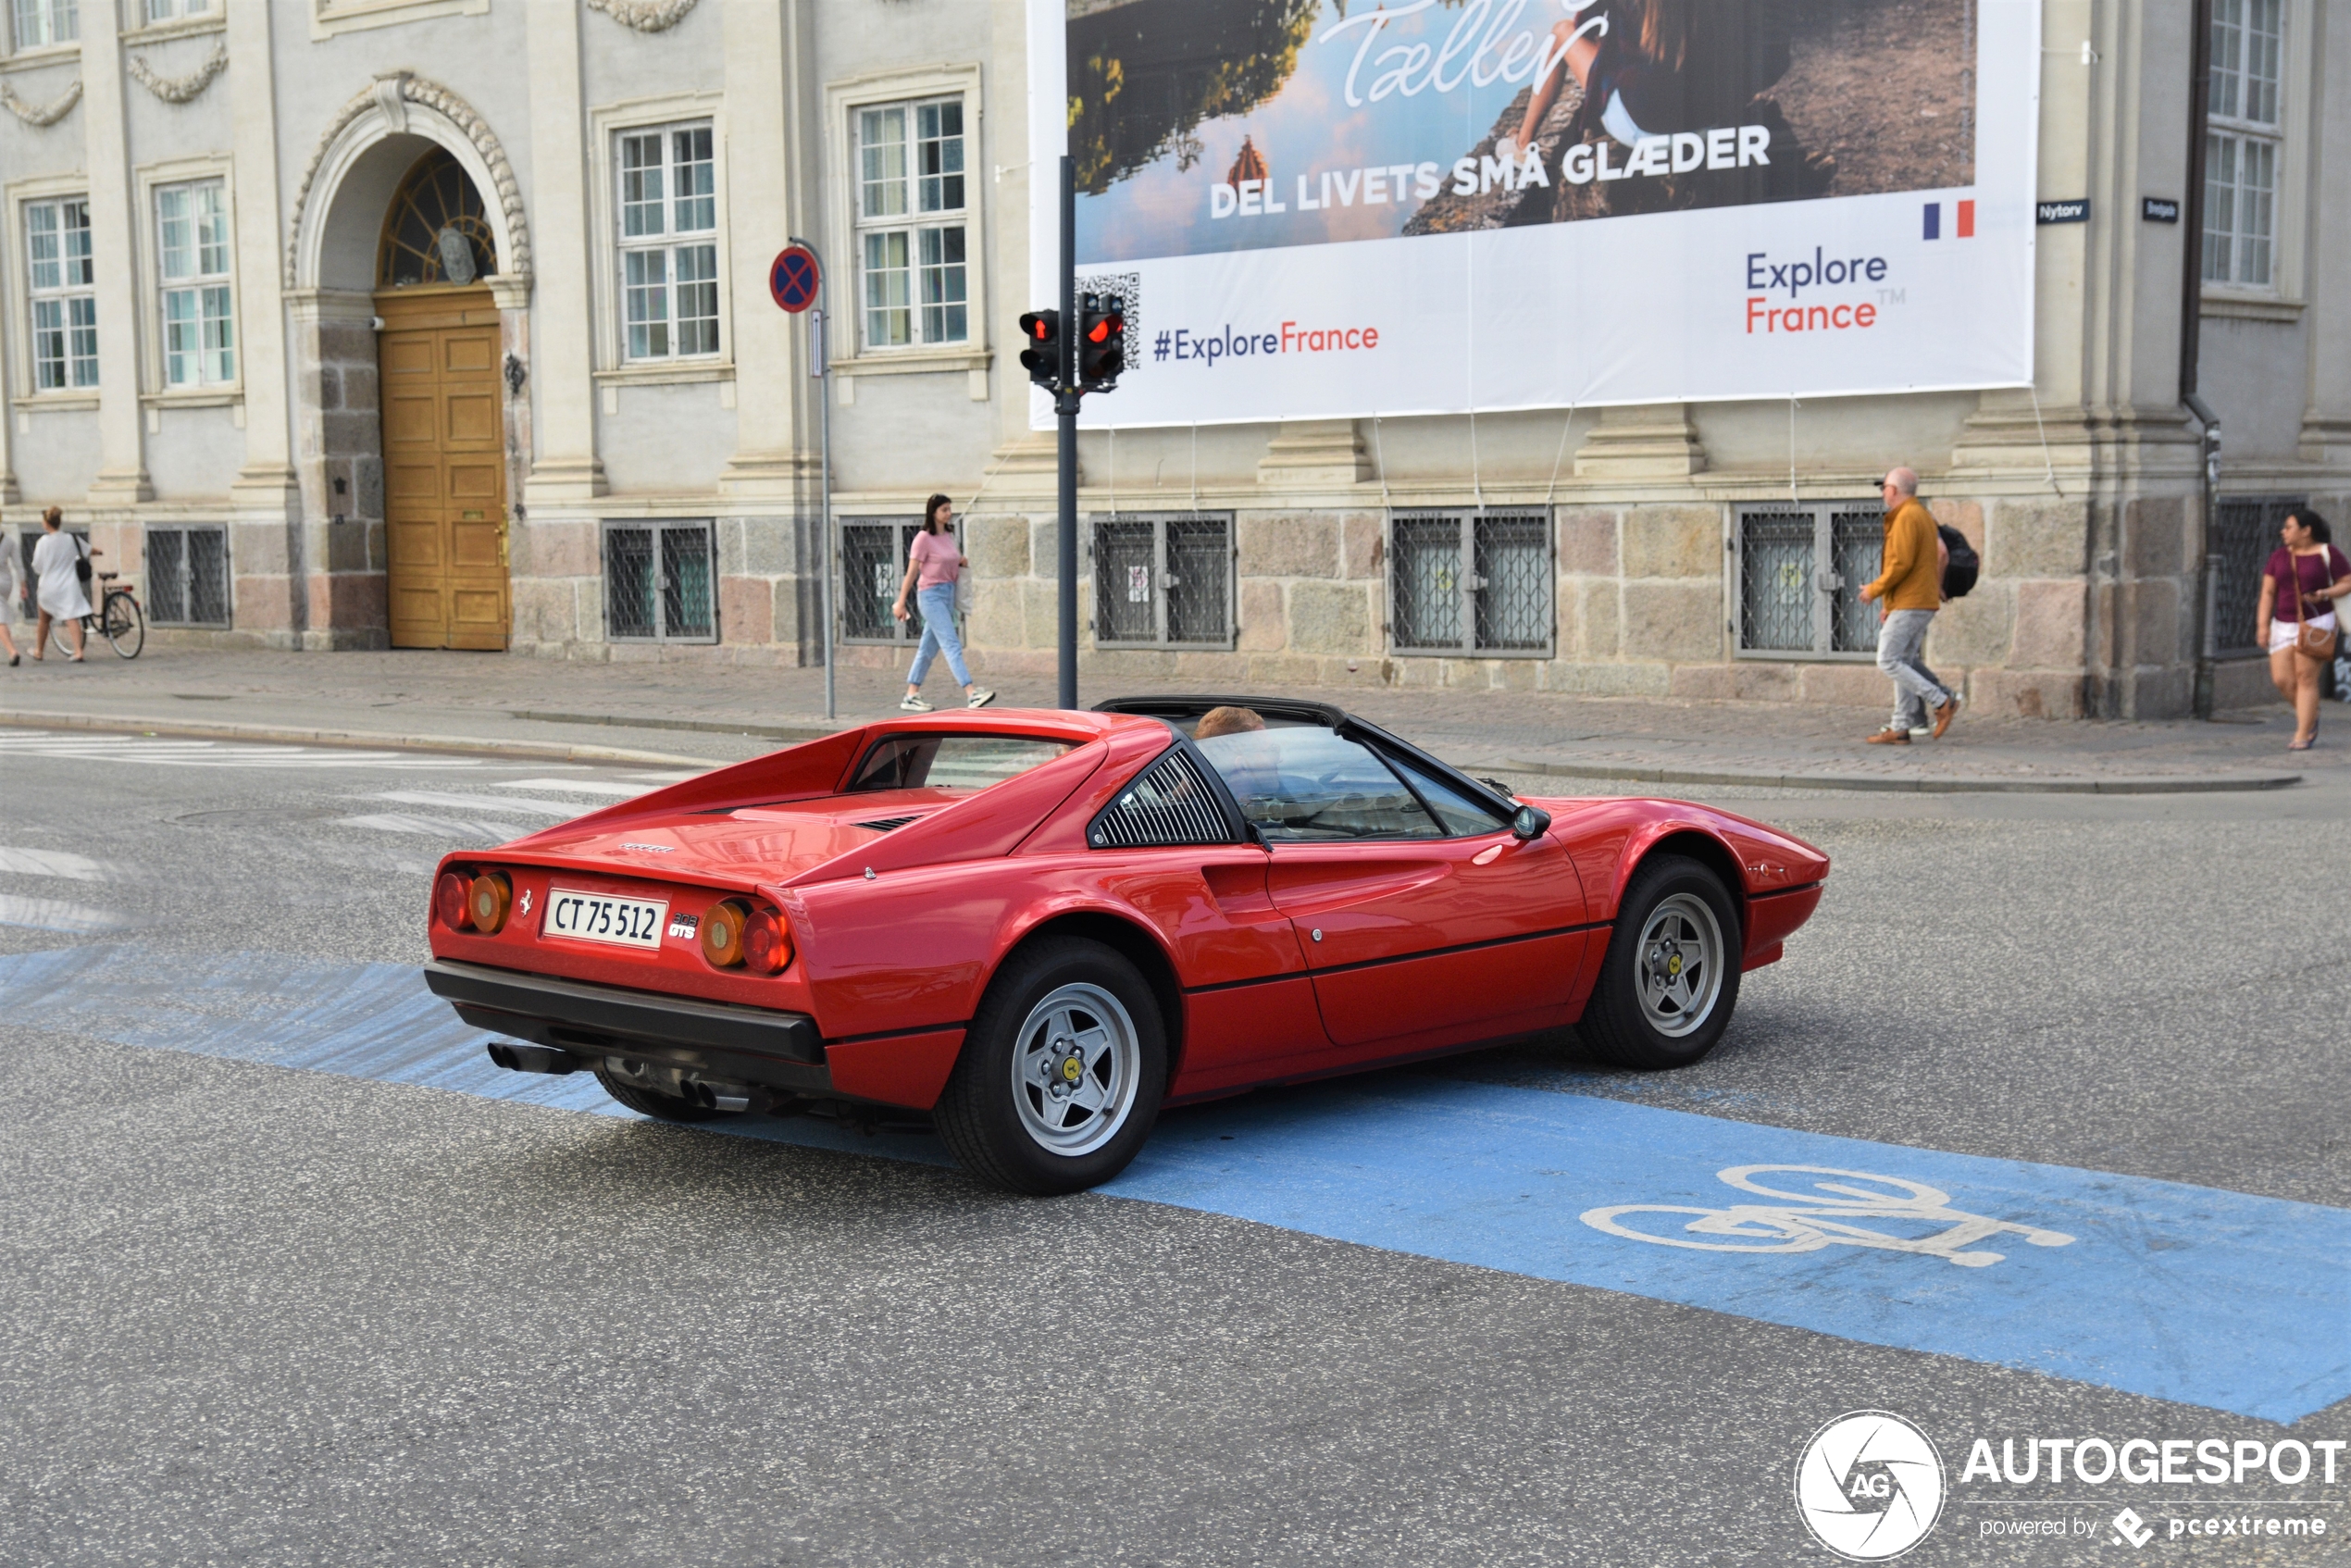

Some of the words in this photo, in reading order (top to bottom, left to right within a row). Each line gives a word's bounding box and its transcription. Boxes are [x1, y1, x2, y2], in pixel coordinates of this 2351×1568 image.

[1211, 180, 1286, 219] DEL
[1297, 161, 1440, 212] LIVETS
[1451, 142, 1549, 197] SMÅ
[1562, 125, 1771, 185] GLÆDER
[2039, 204, 2083, 220] Nytorv
[1747, 246, 1887, 298] Explore
[1747, 297, 1877, 333] France
[1153, 321, 1379, 367] #ExploreFrance
[555, 898, 584, 930] CT
[587, 901, 613, 934] 75
[616, 904, 656, 940] 512
[668, 923, 696, 940] GTS
[673, 913, 699, 927] 308
